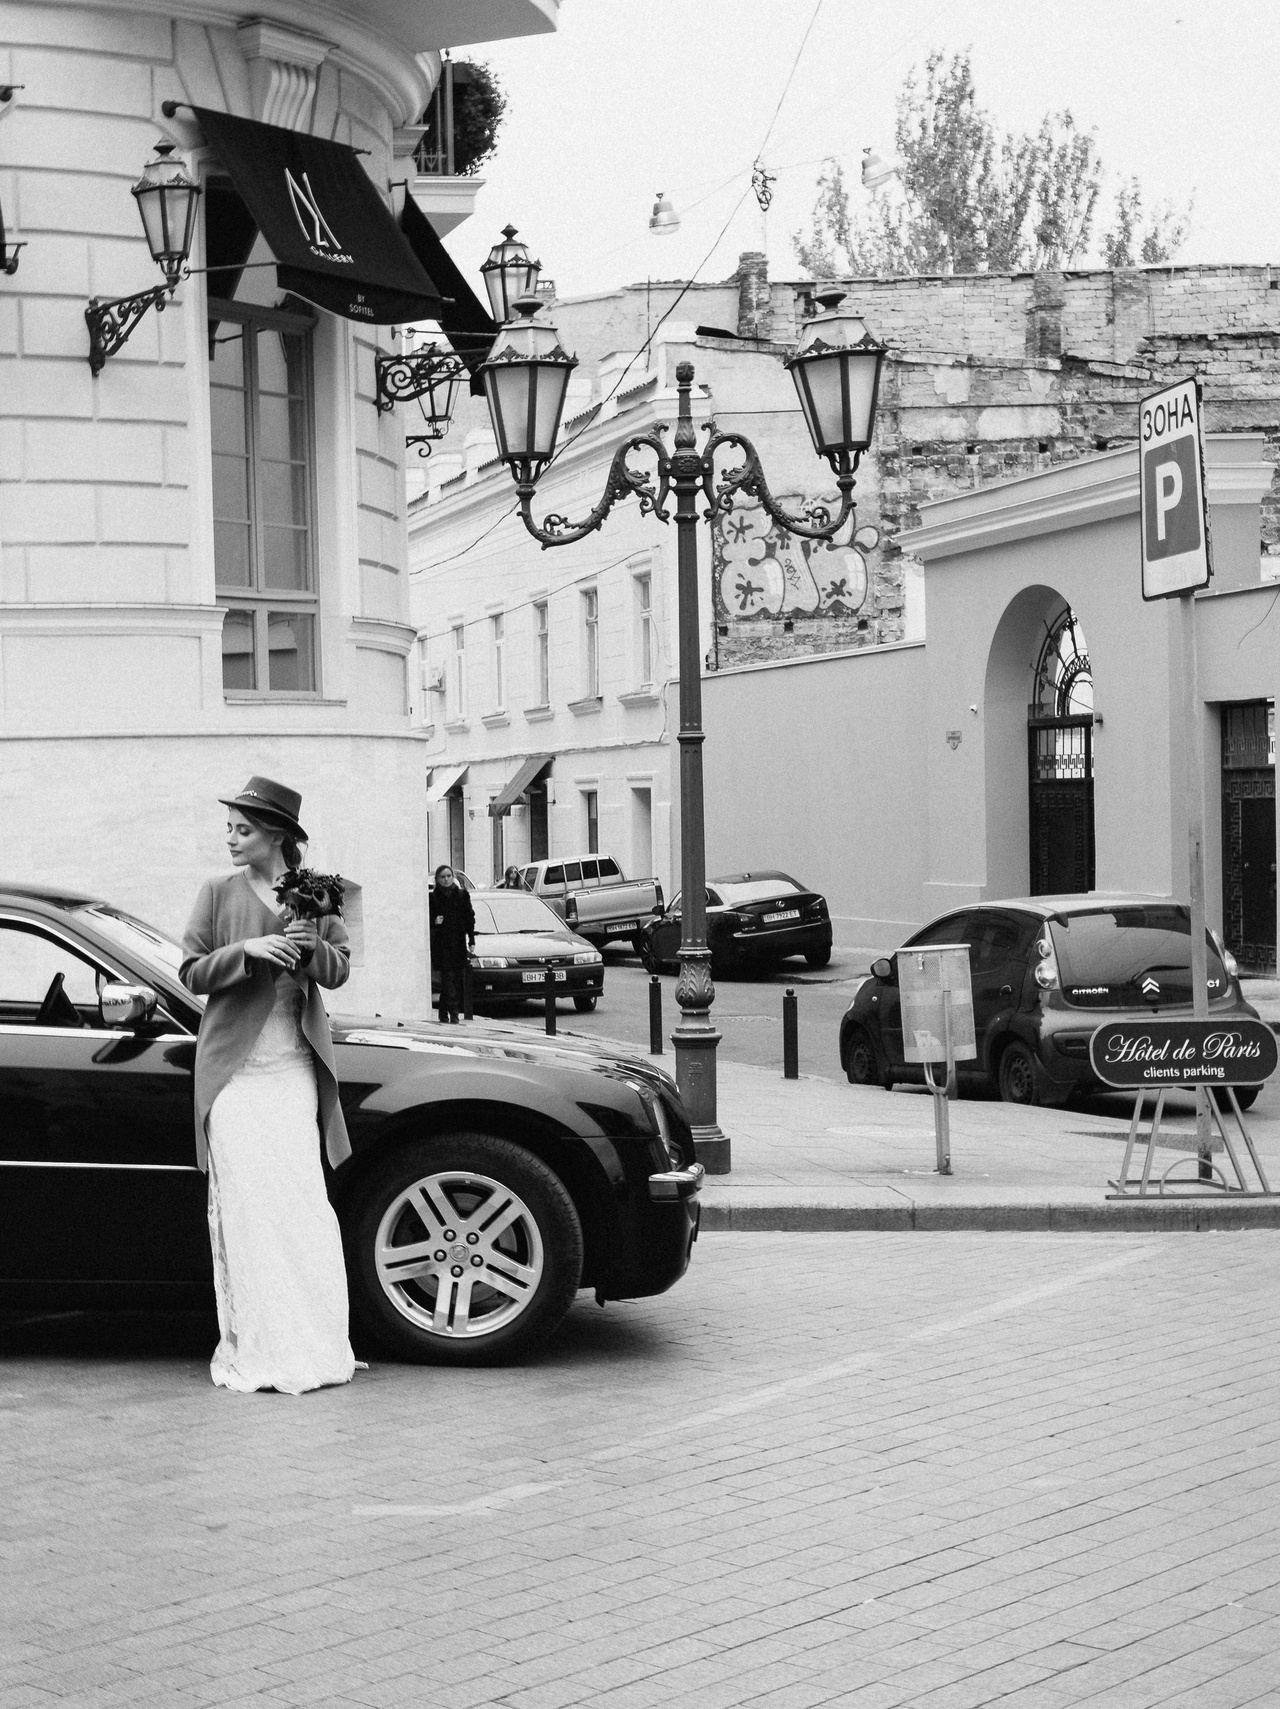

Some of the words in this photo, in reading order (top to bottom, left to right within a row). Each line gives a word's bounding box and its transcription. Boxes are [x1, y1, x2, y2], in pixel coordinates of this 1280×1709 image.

[357, 294, 365, 303] BY
[348, 304, 375, 317] SOFITEL
[1143, 394, 1194, 441] ЗОНА
[1155, 460, 1183, 541] P
[1206, 978, 1220, 988] C1
[1104, 1034, 1171, 1063] Hôtel
[1172, 1038, 1197, 1061] de
[1202, 1032, 1261, 1060] Paris
[1143, 1066, 1180, 1078] clients
[1183, 1064, 1225, 1079] parking
